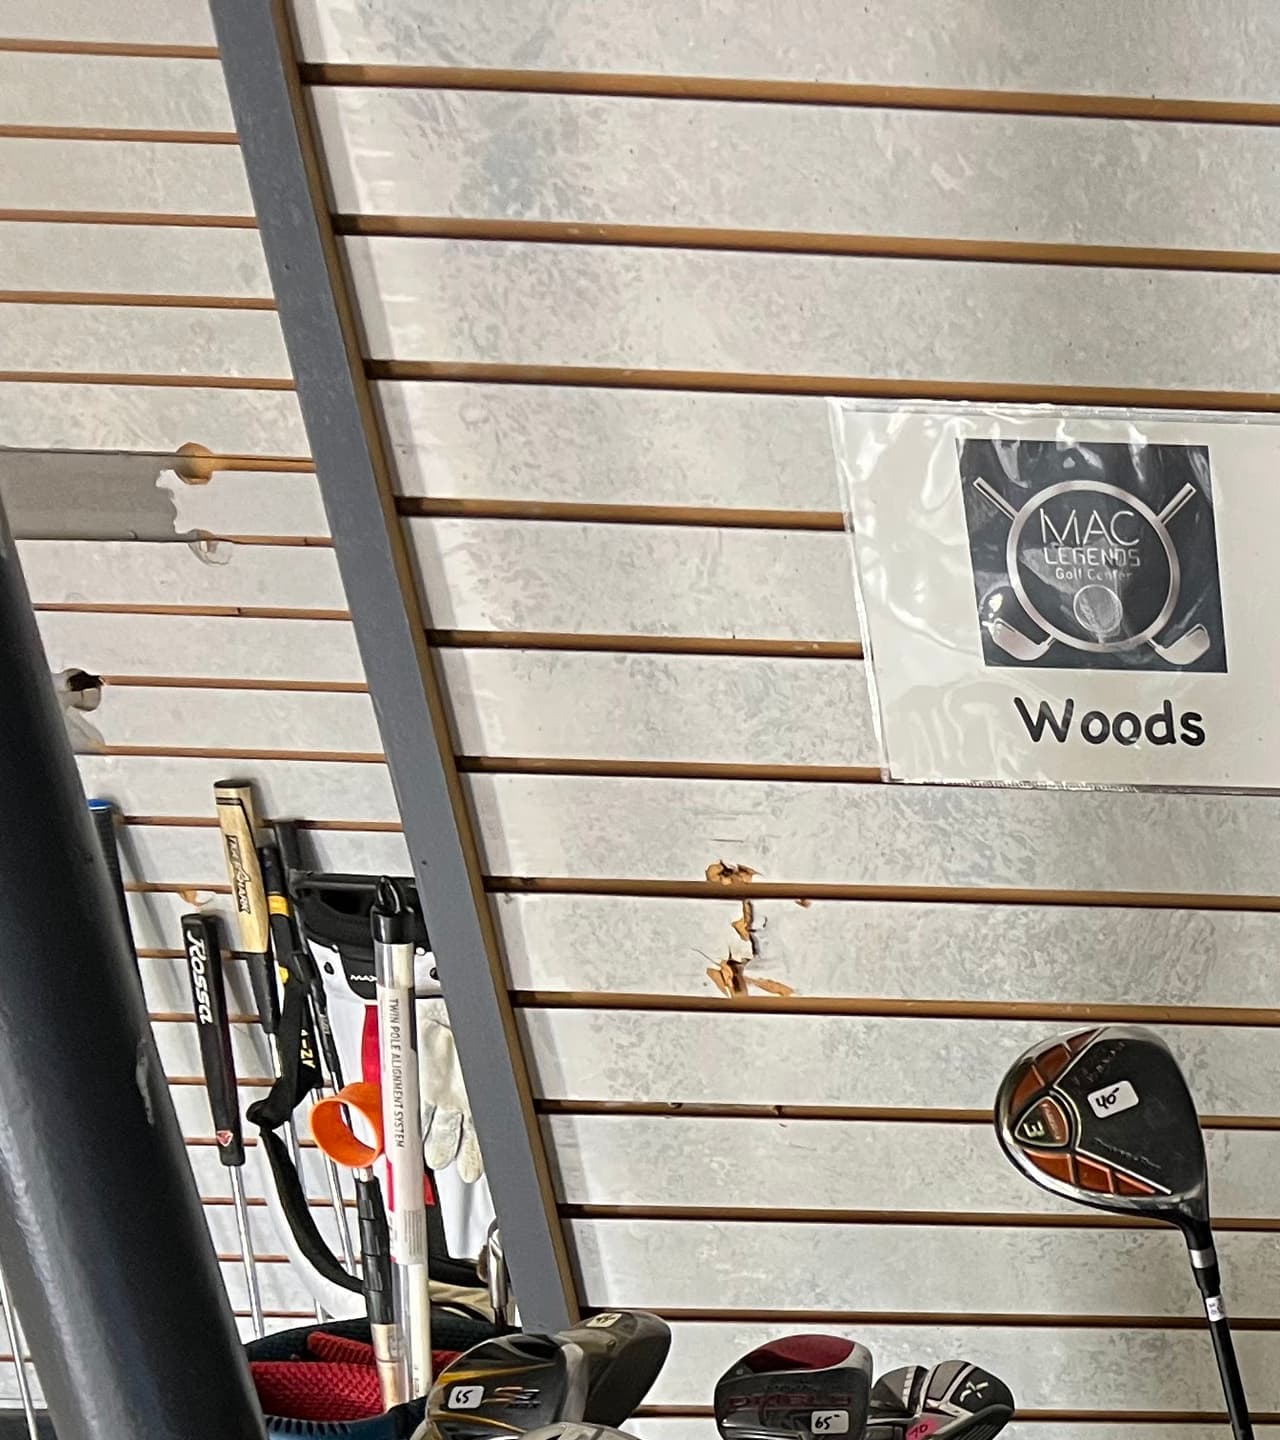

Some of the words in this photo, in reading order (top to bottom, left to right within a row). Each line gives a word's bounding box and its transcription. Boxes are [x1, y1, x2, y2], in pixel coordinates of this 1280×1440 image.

[1038, 508, 1141, 548] MAC
[1043, 547, 1141, 569] LEGENDS
[1013, 697, 1205, 746] Woods
[391, 997, 402, 1022] TWIN
[391, 1024, 402, 1051] POLE
[391, 1053, 404, 1110] ALIGNMENT
[394, 1111, 404, 1149] SYSTEM
